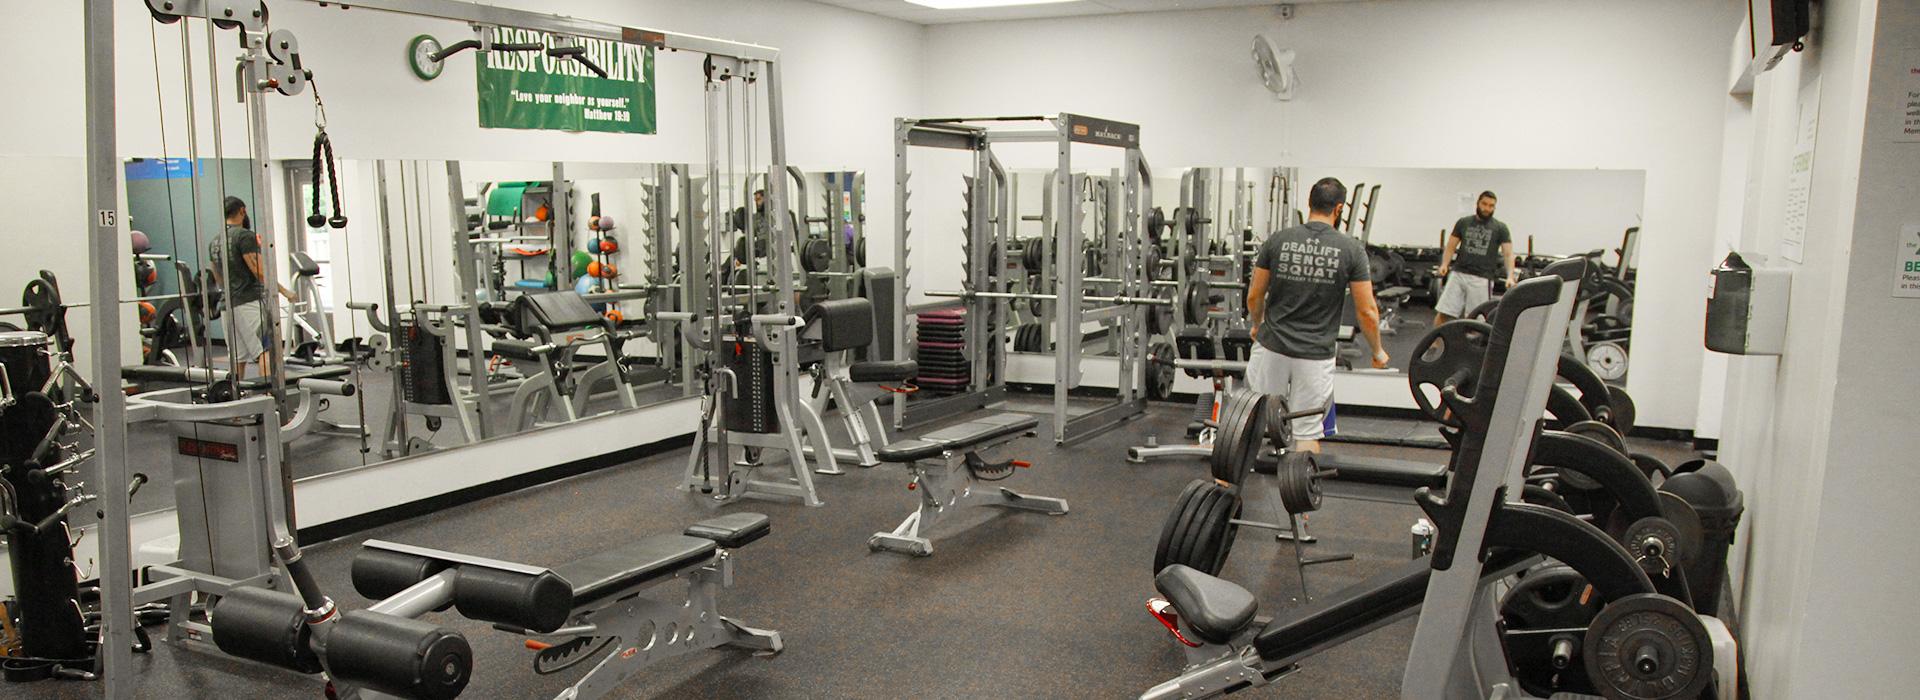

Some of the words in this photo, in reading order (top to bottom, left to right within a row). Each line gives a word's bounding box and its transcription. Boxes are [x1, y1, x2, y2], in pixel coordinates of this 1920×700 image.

[487, 26, 646, 83] RESPONSIBILITY
[534, 93, 553, 104] your
[554, 93, 585, 106] neighbor
[587, 97, 595, 106] as
[584, 108, 613, 121] Matthew
[100, 211, 115, 226] 15
[1281, 242, 1341, 257] DEADLIFT
[1279, 252, 1340, 269] BENCH
[1904, 261, 1920, 272] BE
[1278, 263, 1338, 279] SQUAT
